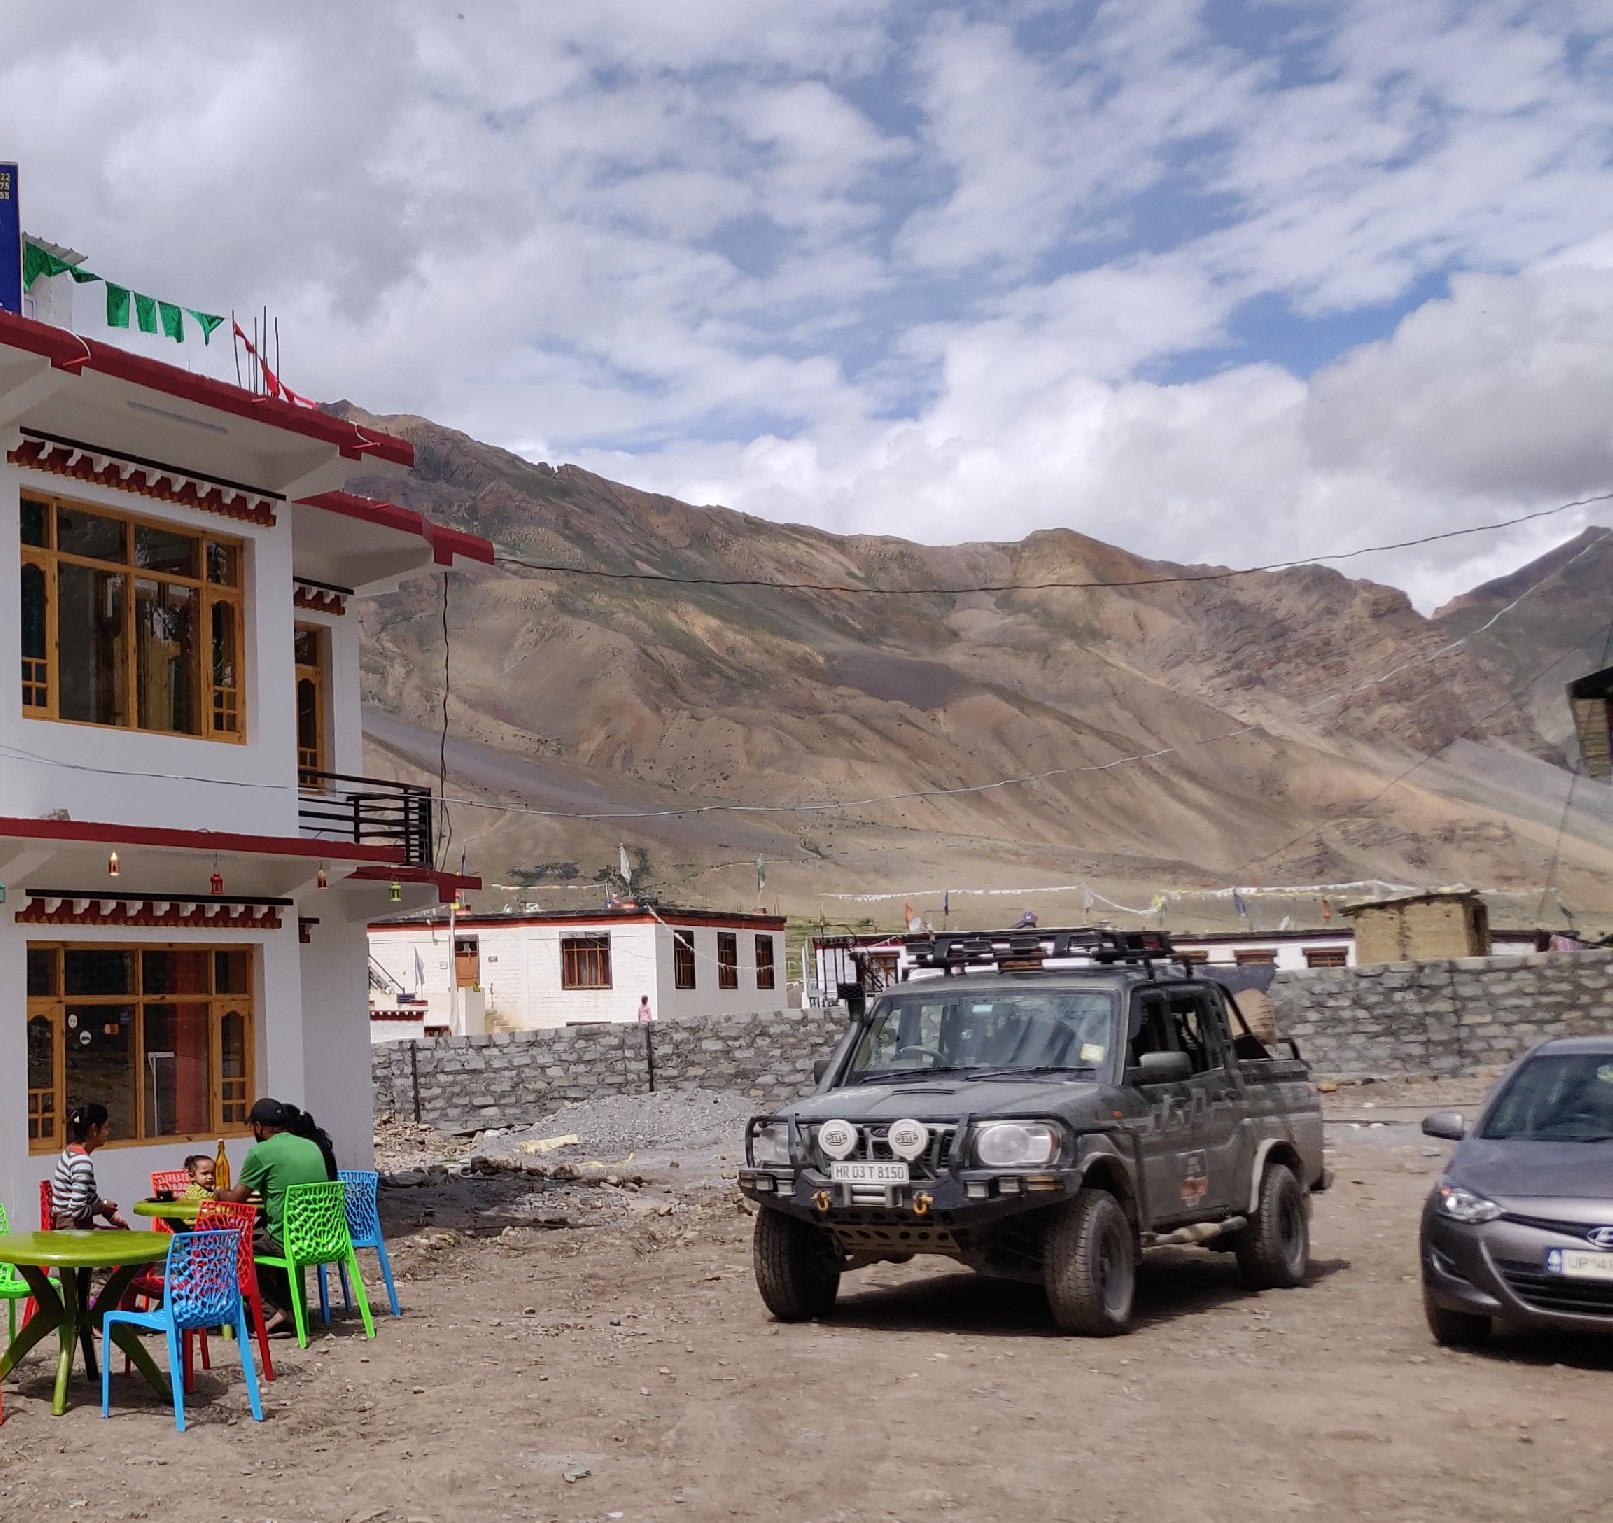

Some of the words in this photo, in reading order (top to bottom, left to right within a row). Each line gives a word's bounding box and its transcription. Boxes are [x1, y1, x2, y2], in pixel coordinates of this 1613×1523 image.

[836, 1165, 850, 1179] HR
[852, 1166, 865, 1179] 03
[868, 1166, 875, 1179] T
[877, 1166, 905, 1180] 8150
